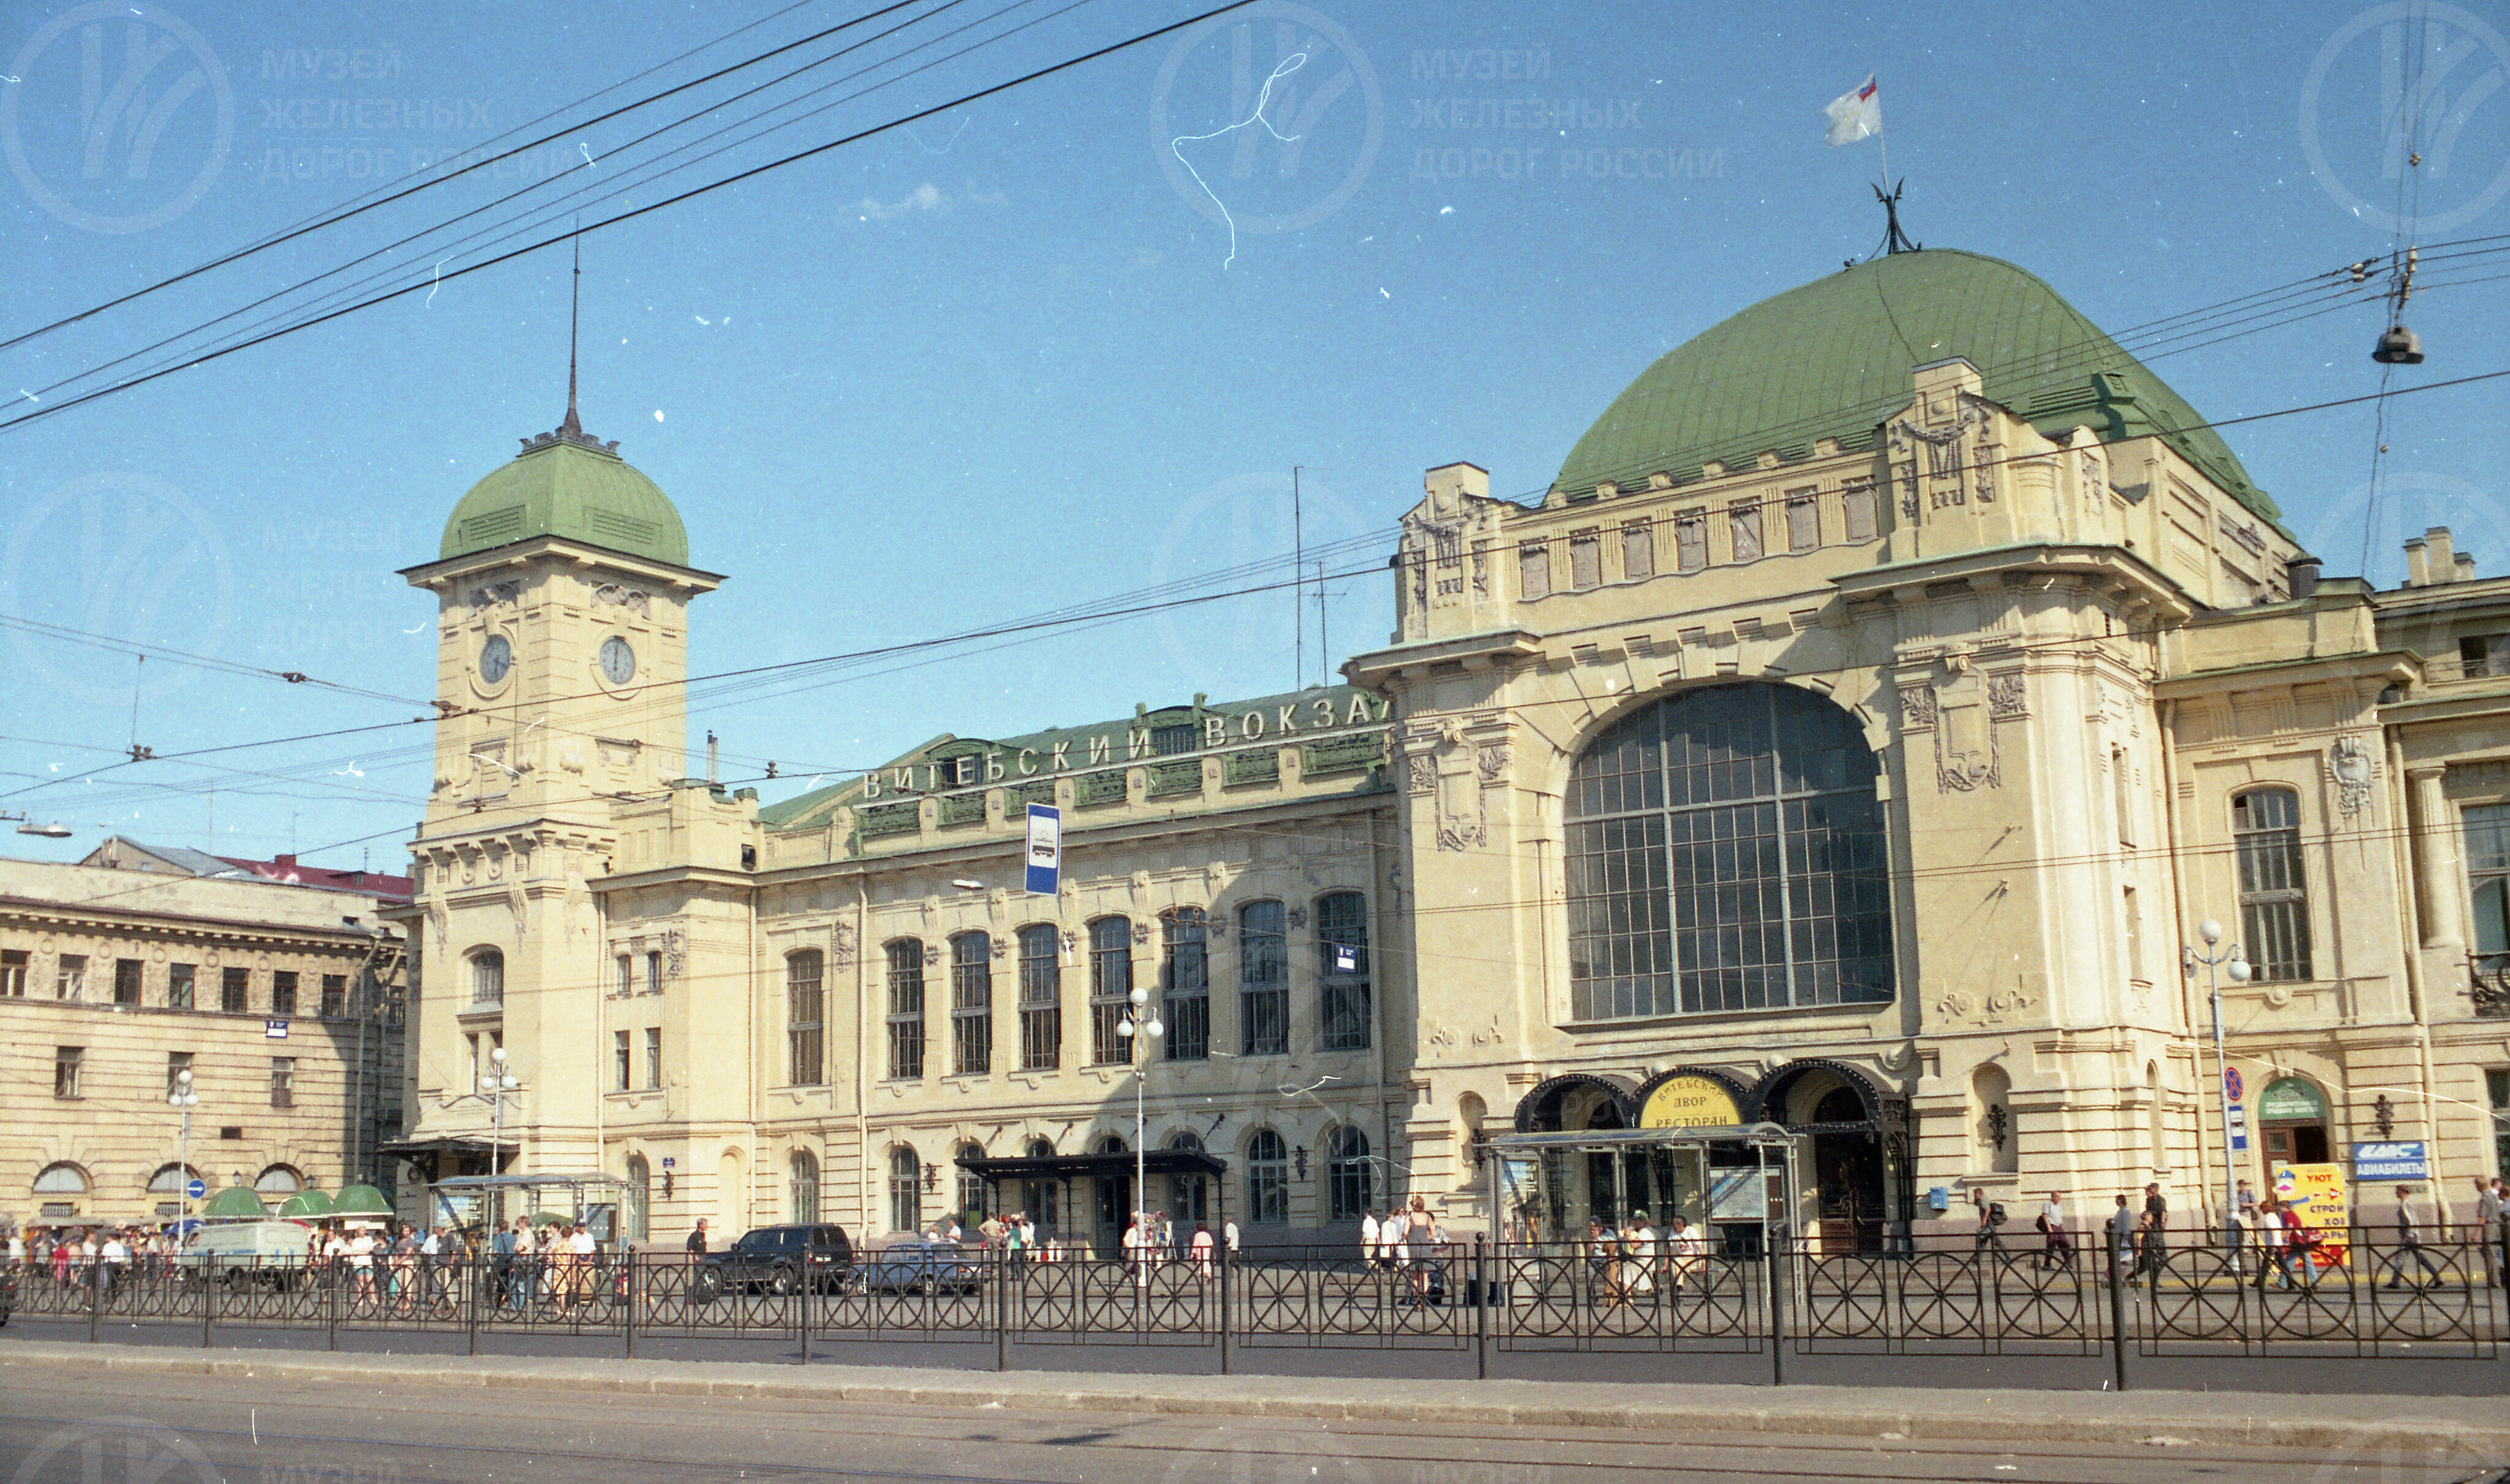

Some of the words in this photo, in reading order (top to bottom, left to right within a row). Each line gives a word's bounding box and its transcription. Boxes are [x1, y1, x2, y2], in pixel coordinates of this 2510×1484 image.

[1674, 1096, 1707, 1108] ДВОР
[1656, 1116, 1727, 1127] РЕСТОРАН
[2357, 1162, 2425, 1175] АВИАБИЛЕТЫ
[2310, 1203, 2344, 1213] СТРОЙ
